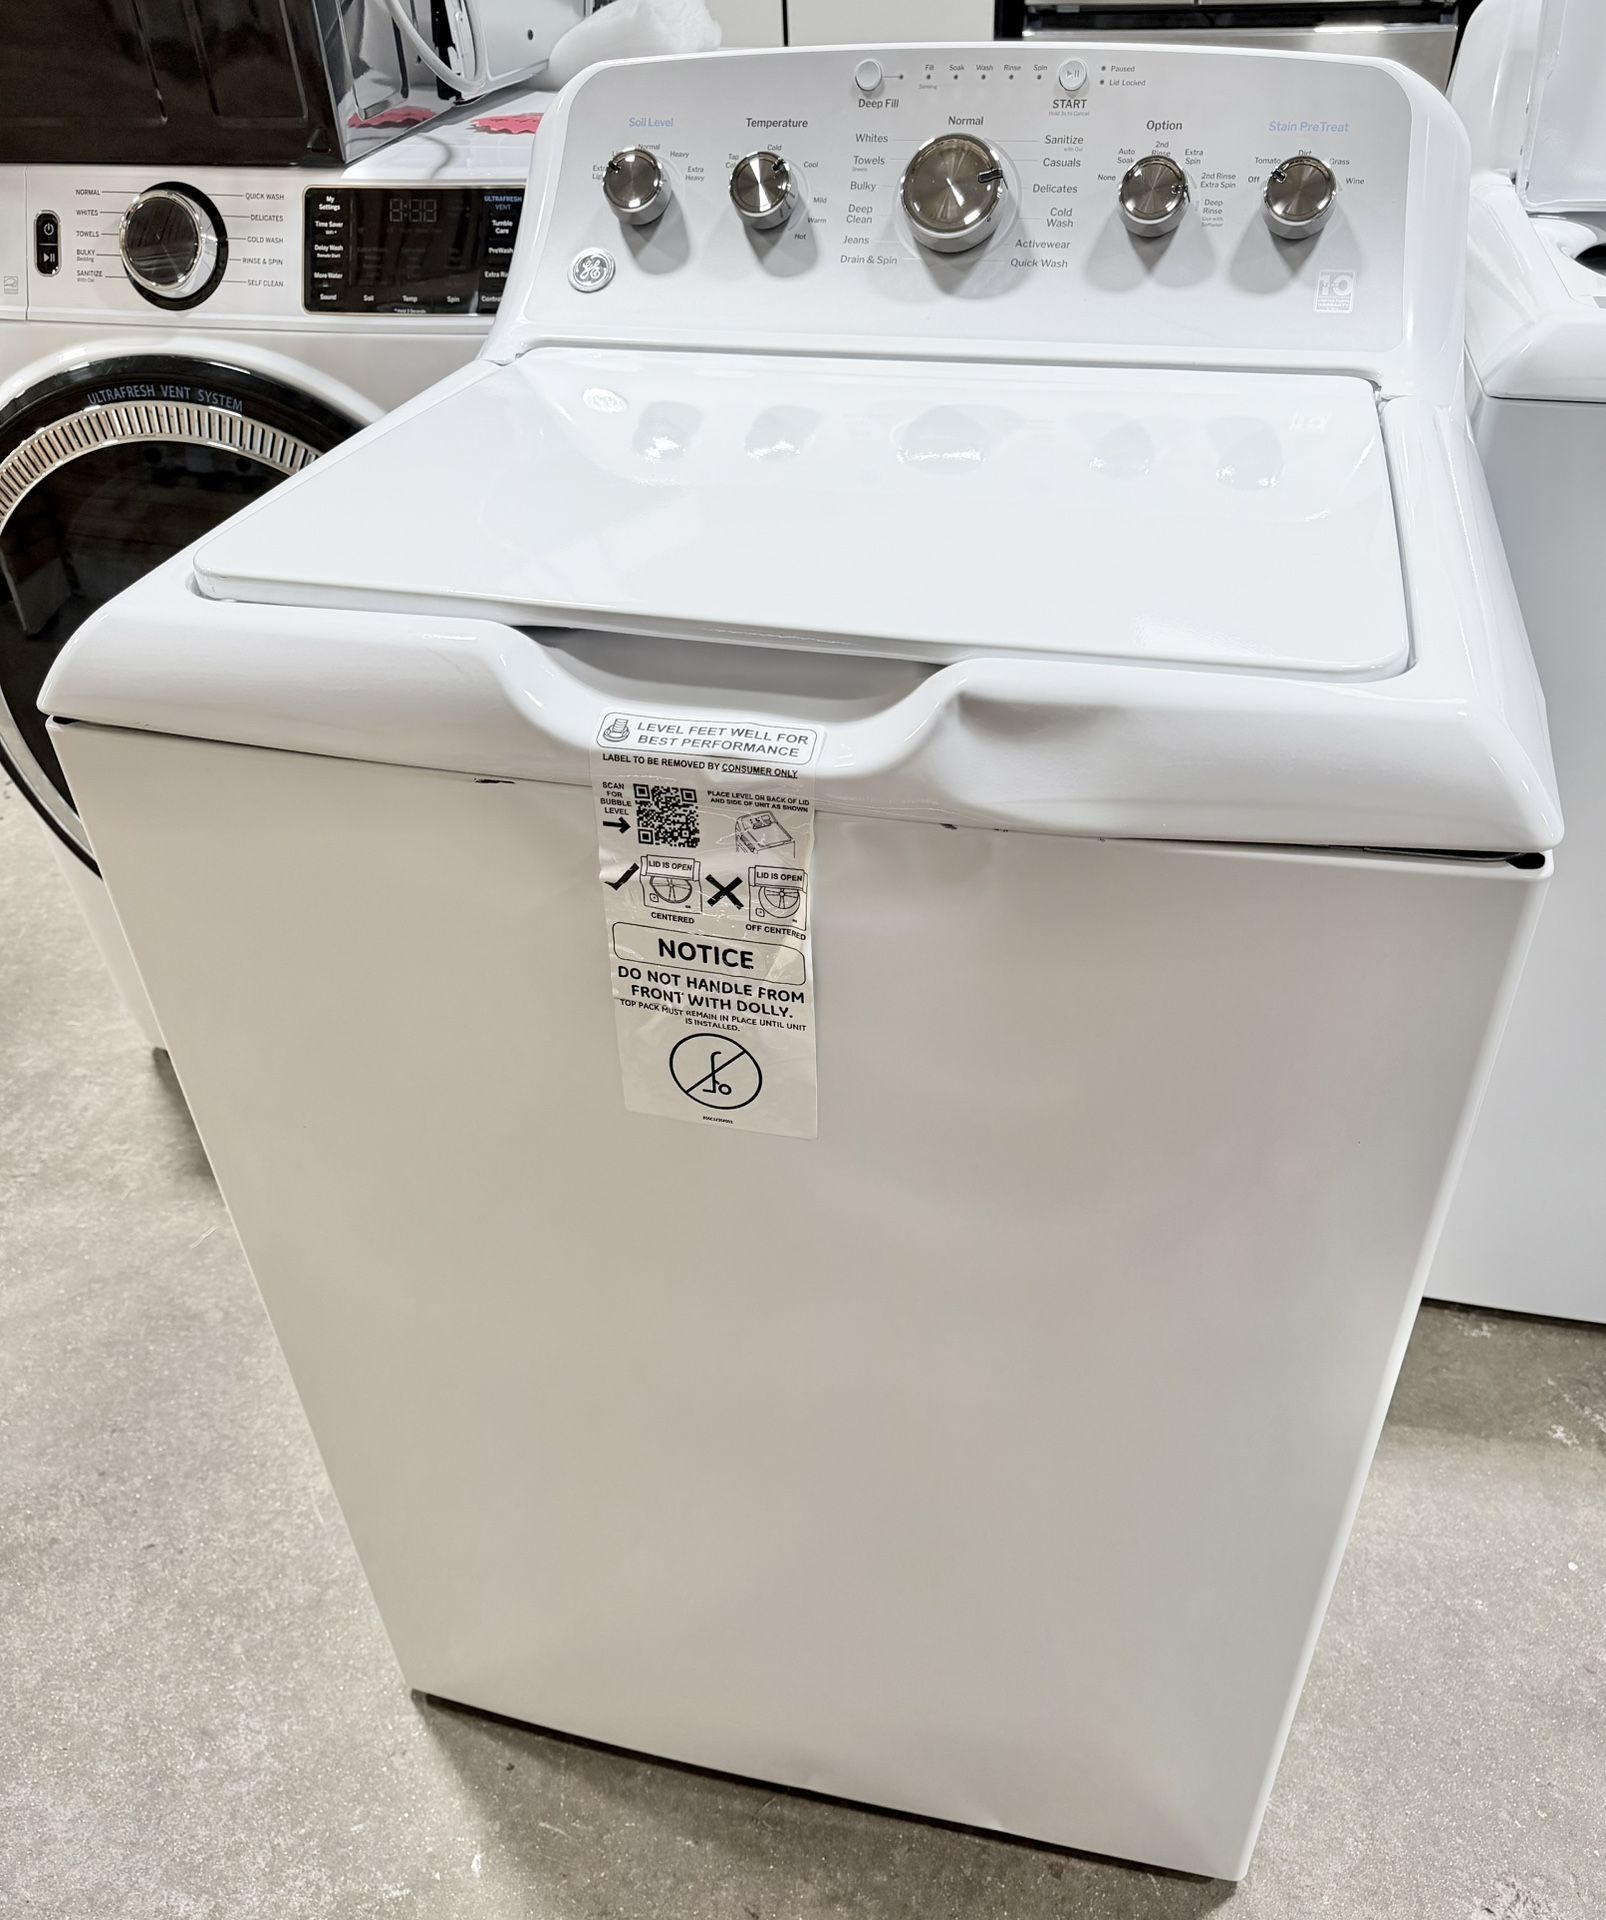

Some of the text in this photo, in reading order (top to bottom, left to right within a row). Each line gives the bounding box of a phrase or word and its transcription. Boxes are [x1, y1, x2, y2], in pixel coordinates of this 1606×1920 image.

[1033, 64, 1048, 72] Spin
[858, 98, 899, 109] Deep Fill
[1052, 99, 1088, 109] START
[628, 117, 673, 127] Soil Level
[745, 118, 808, 129] Temperature
[948, 116, 984, 126] Normal
[1146, 120, 1183, 131] Option
[1269, 121, 1349, 132] Stain PreTreat
[855, 133, 889, 143] Whites
[1044, 135, 1084, 145] Sanitize
[728, 153, 740, 161] Tap
[853, 155, 885, 165] Towels
[1042, 157, 1081, 167] Casuals
[1185, 157, 1201, 165] Spin
[1201, 172, 1237, 180] 2nd Rinse
[850, 181, 877, 192] Bulky
[1032, 183, 1079, 193] Delicates
[1220, 181, 1236, 189] Spin
[245, 192, 265, 200] QUICK
[326, 195, 335, 203] My
[319, 203, 341, 211] Settings
[1204, 199, 1223, 207] Deep
[848, 204, 873, 214] Deep
[1050, 207, 1073, 217] Cold
[1203, 207, 1223, 215] Rinse
[250, 214, 284, 222] DELICATES
[846, 215, 873, 224] Clean
[1046, 218, 1074, 228] Wash
[842, 236, 870, 244] Jeans
[1015, 239, 1071, 249] Activewear
[314, 244, 329, 252] Delay
[840, 255, 898, 265] Drain & Spin
[1010, 258, 1068, 268] Quick Wash
[320, 293, 337, 301] Sound
[402, 295, 418, 303] Temp
[446, 296, 460, 304] Spin
[87, 384, 243, 412] ULTRAFRESH VENT SYSTEM
[637, 721, 808, 745] LEVEL FEET WELL FOR
[638, 735, 799, 757] BEST PERFORMANCE
[602, 753, 798, 778] LABEL TO BE REMOVED BY CONSUMER ONLY
[602, 781, 625, 790] SCAN
[606, 790, 623, 798] FOR
[731, 791, 753, 800] LEVEL
[766, 795, 786, 803] BACK
[600, 797, 632, 807] BUBBLE
[726, 798, 742, 806] SIDE
[782, 804, 808, 812] SHOWN
[604, 807, 630, 816] LEVEL
[671, 863, 692, 871] OPEN
[756, 871, 769, 879] LID
[780, 873, 803, 881] OPEN
[650, 911, 695, 924] CENTERED
[745, 923, 806, 940] OFF CENTERED
[658, 938, 754, 969] NOTICE
[618, 966, 804, 1004] DO NOT HANDLE FROM
[631, 984, 793, 1018] FRONT WITH DOLLY.
[620, 999, 636, 1007] TOP
[638, 1001, 660, 1011] PACK
[661, 1005, 683, 1016] MUST
[686, 1010, 717, 1020] REMAIN
[731, 1015, 757, 1025] PLACE
[759, 1019, 784, 1028] UNTIL
[786, 1022, 807, 1031] UNIT
[694, 1019, 740, 1032] INSTALLED.
